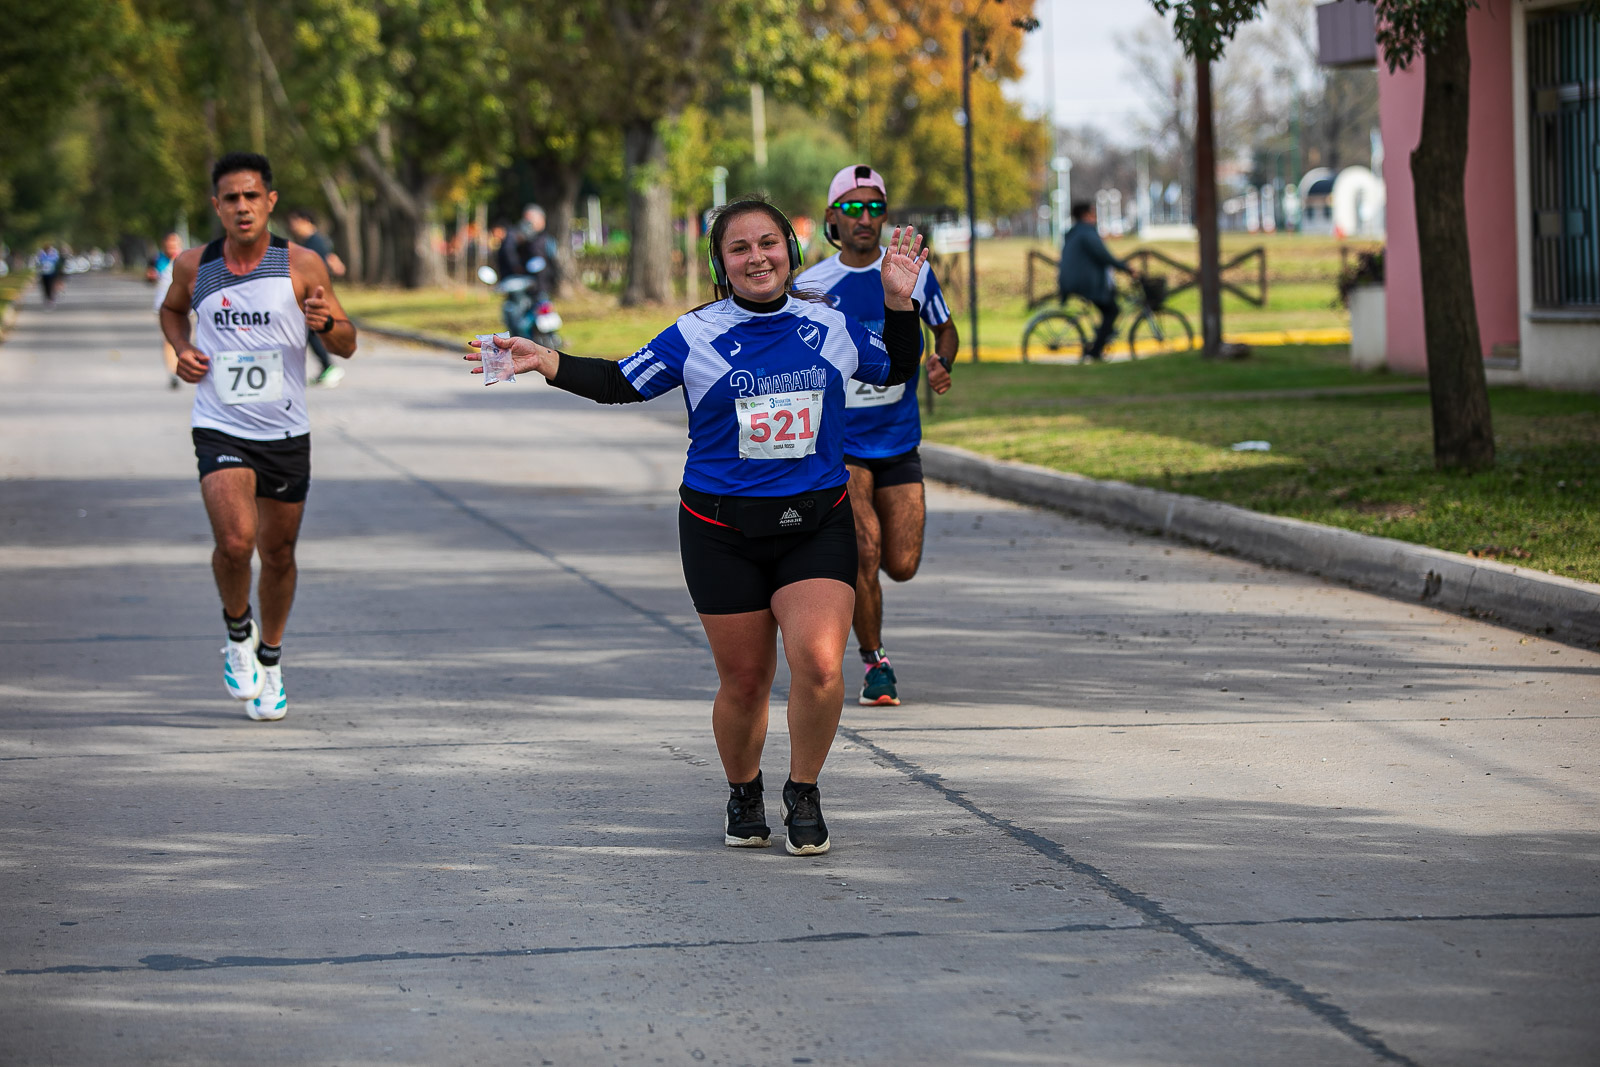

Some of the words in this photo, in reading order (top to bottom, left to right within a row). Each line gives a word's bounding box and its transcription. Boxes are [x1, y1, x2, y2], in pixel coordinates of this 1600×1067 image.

[214, 309, 270, 325] ATENAS
[228, 366, 267, 391] 70
[730, 370, 755, 397] 3
[757, 365, 827, 396] MARATÓN
[749, 408, 814, 443] 521
